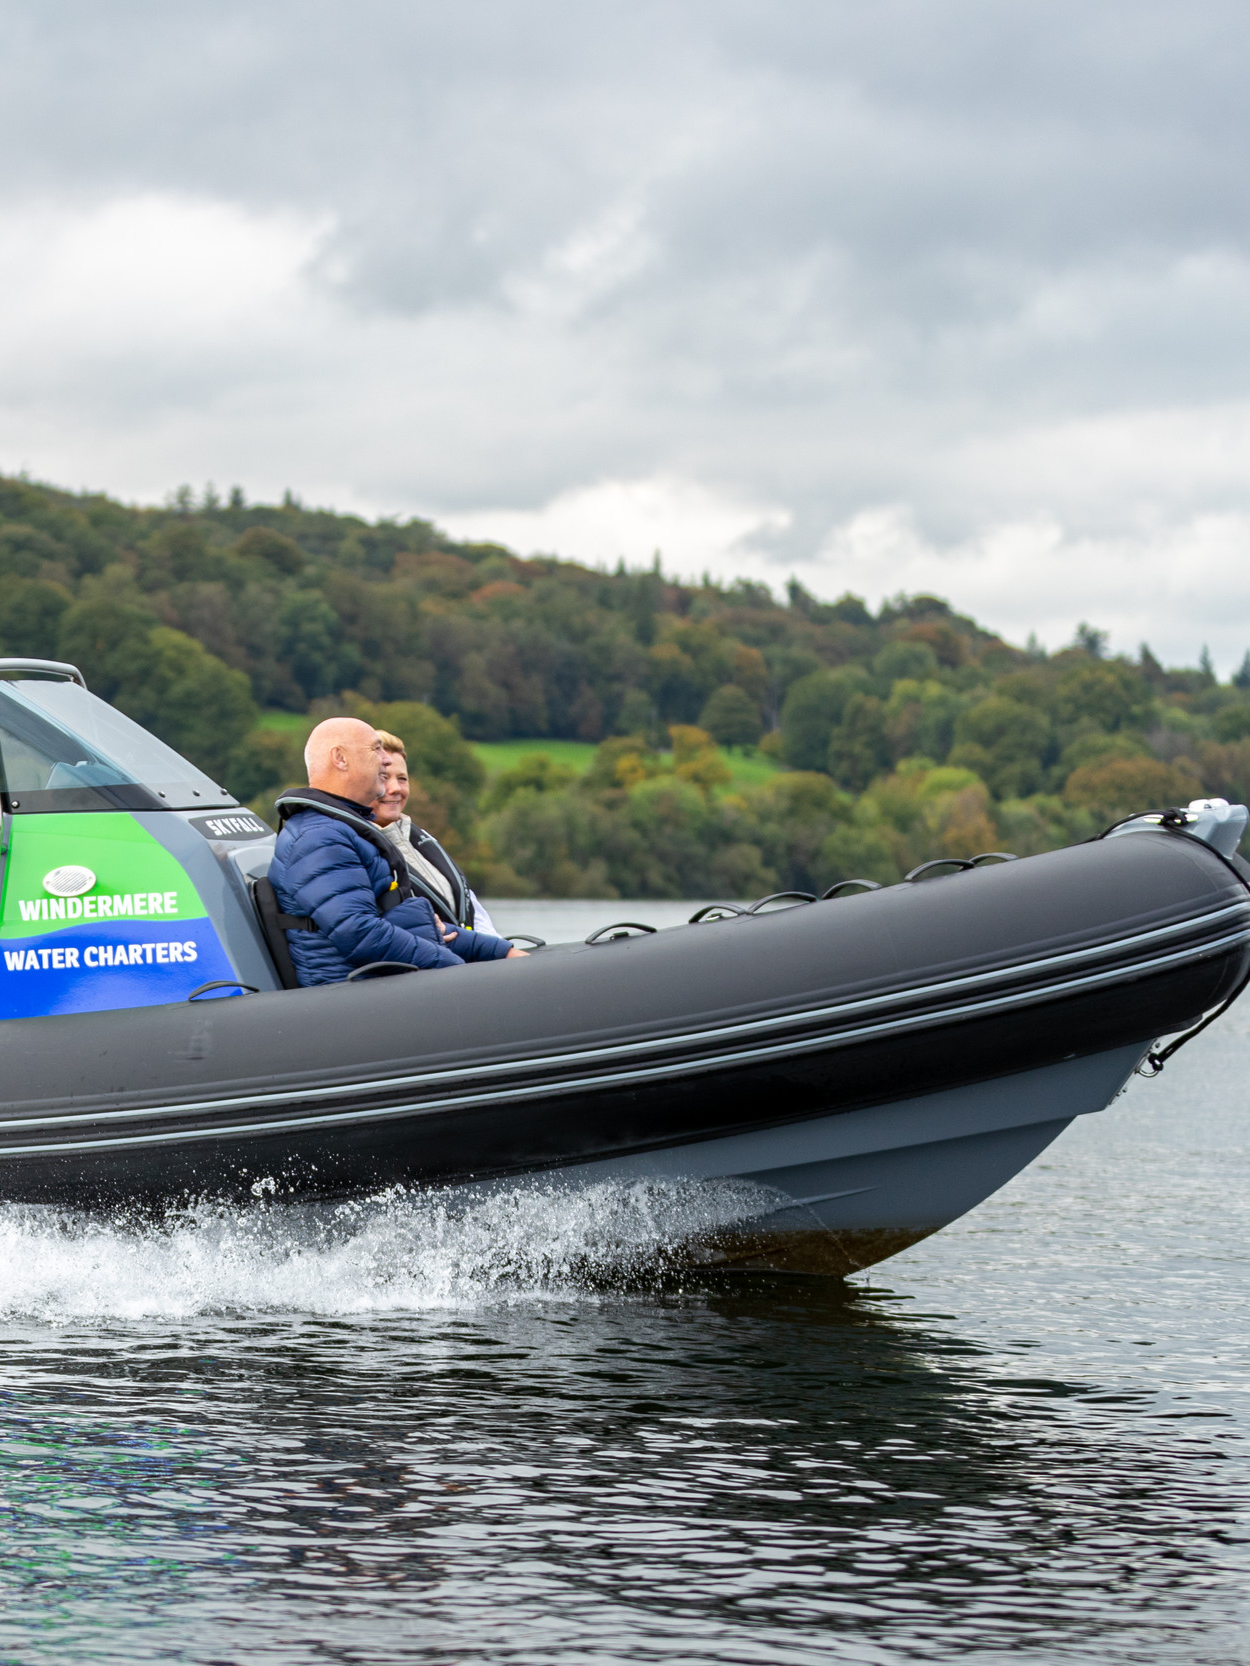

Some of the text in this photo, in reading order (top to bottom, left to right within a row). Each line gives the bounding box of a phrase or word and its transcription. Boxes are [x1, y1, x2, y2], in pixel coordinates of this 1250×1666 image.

[205, 817, 265, 836] SKYFALL
[18, 891, 179, 921] WINDERMERE
[3, 941, 198, 971] WATER CHARTERS
